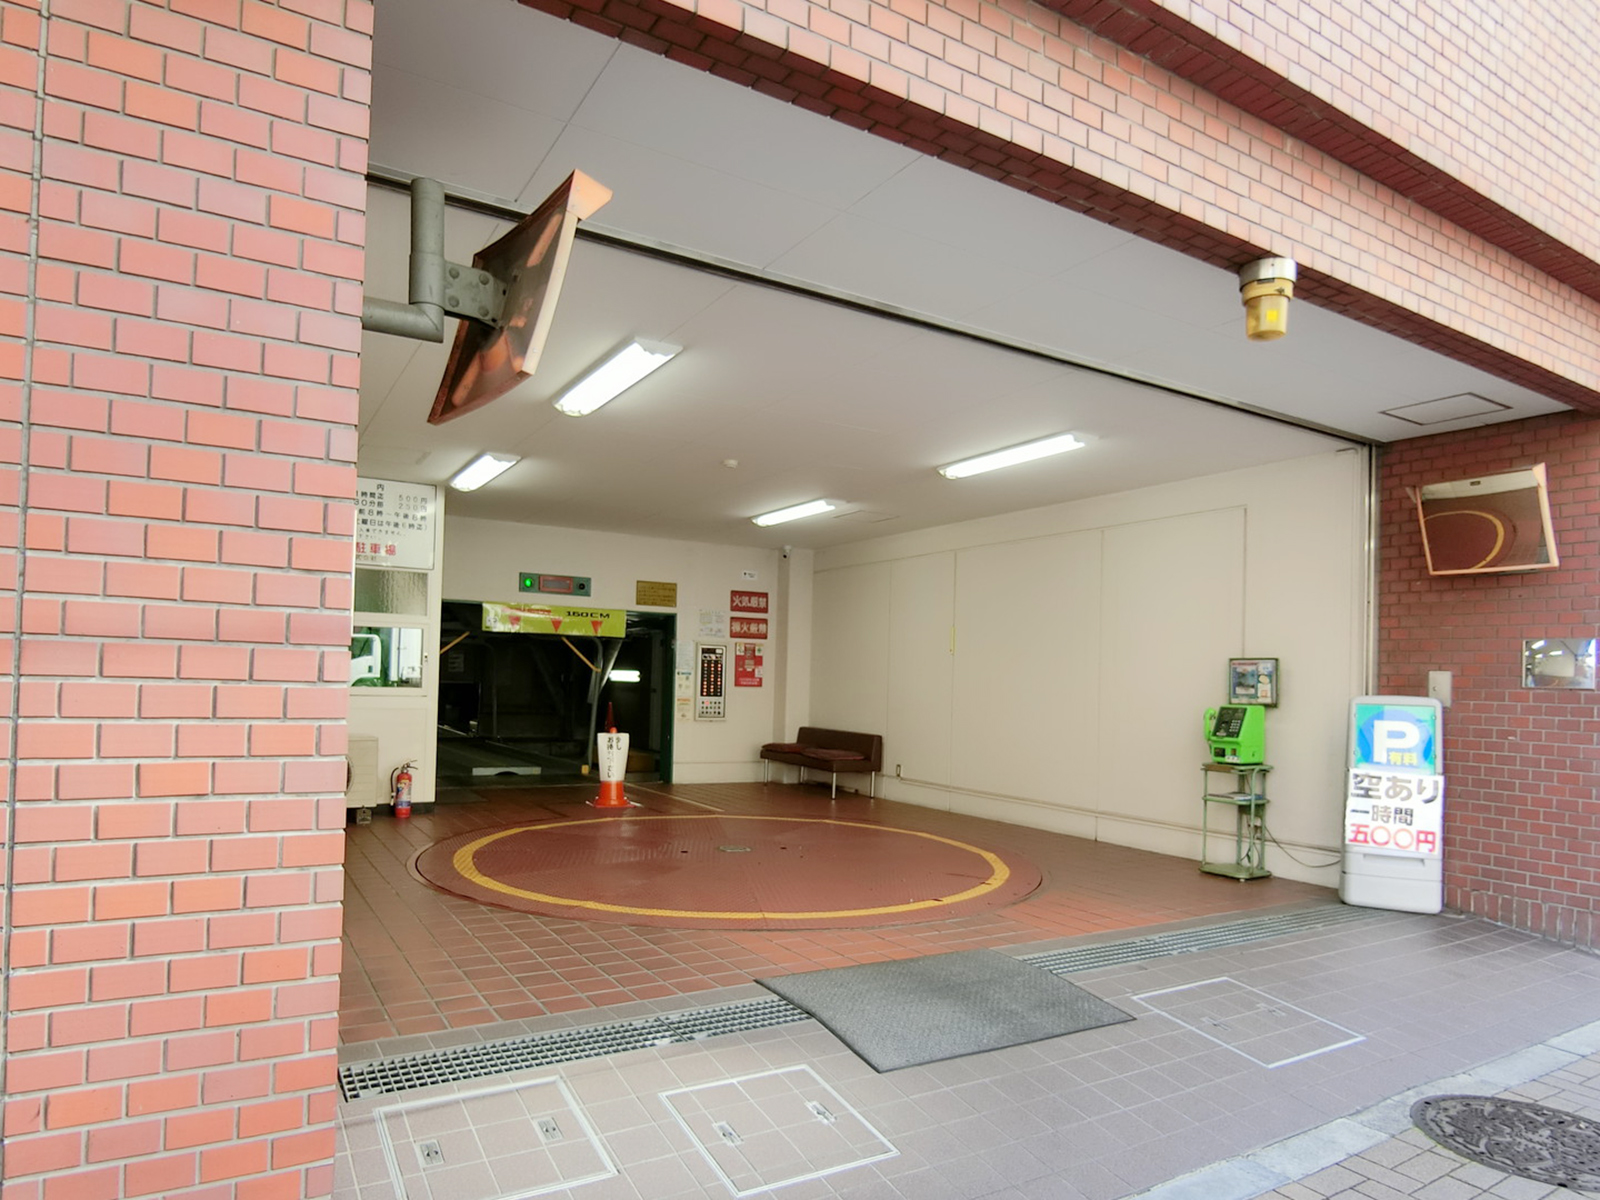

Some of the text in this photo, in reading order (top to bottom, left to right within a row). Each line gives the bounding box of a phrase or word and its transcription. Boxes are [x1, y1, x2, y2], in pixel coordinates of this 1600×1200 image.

[1373, 720, 1420, 764] P
[1350, 773, 1439, 804] 空あり
[1350, 804, 1414, 826] 一時間
